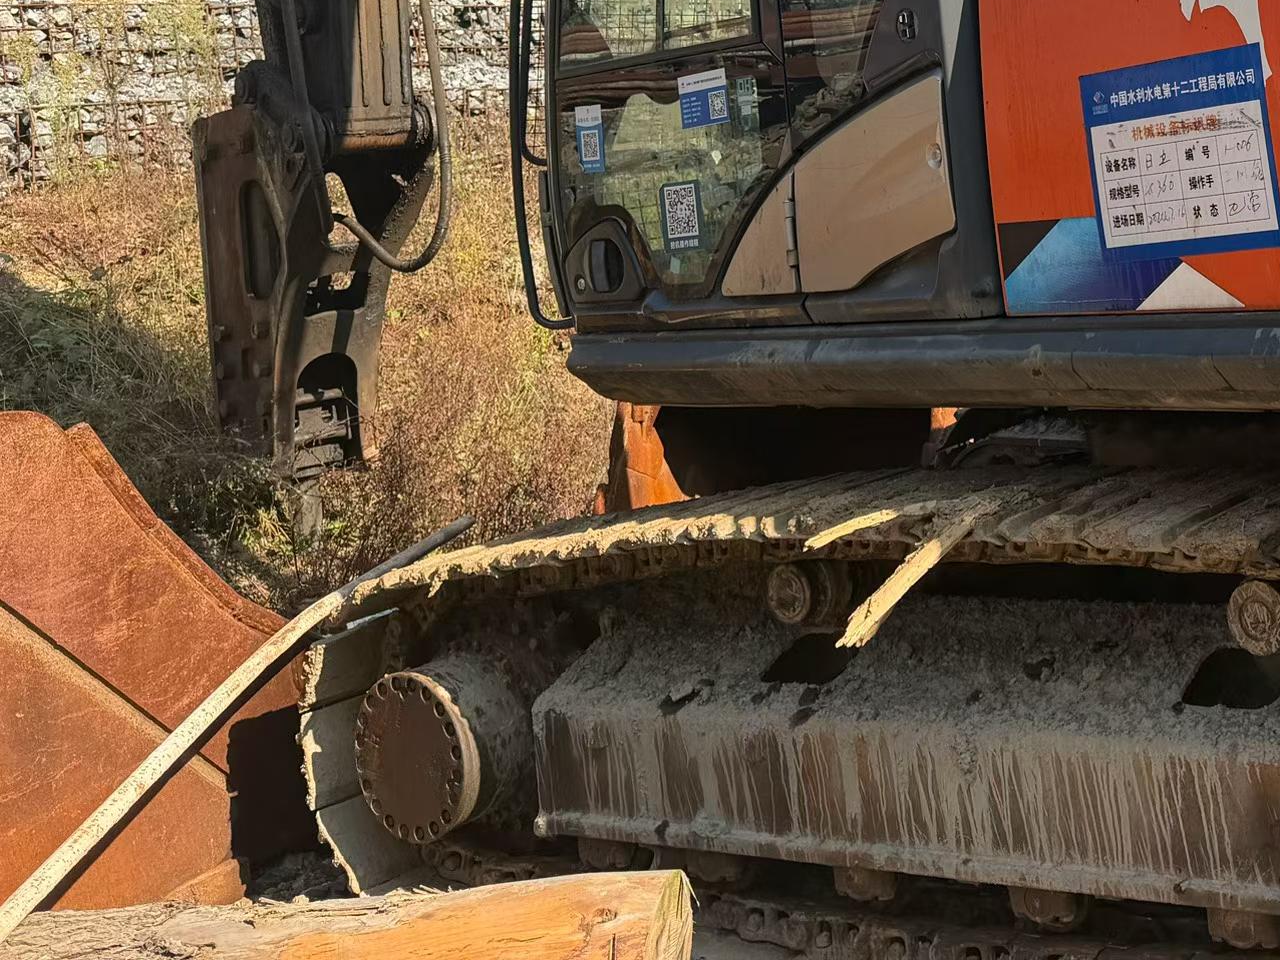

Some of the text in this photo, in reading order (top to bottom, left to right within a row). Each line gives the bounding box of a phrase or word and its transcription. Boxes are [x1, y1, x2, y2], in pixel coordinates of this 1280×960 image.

[1110, 68, 1255, 108] 中国水利水电第十二工程局有限公司
[1105, 157, 1137, 174] 设备名称
[1188, 174, 1214, 191] 操作手
[1109, 183, 1140, 201] 规格型号
[1112, 212, 1145, 229] 进场日期
